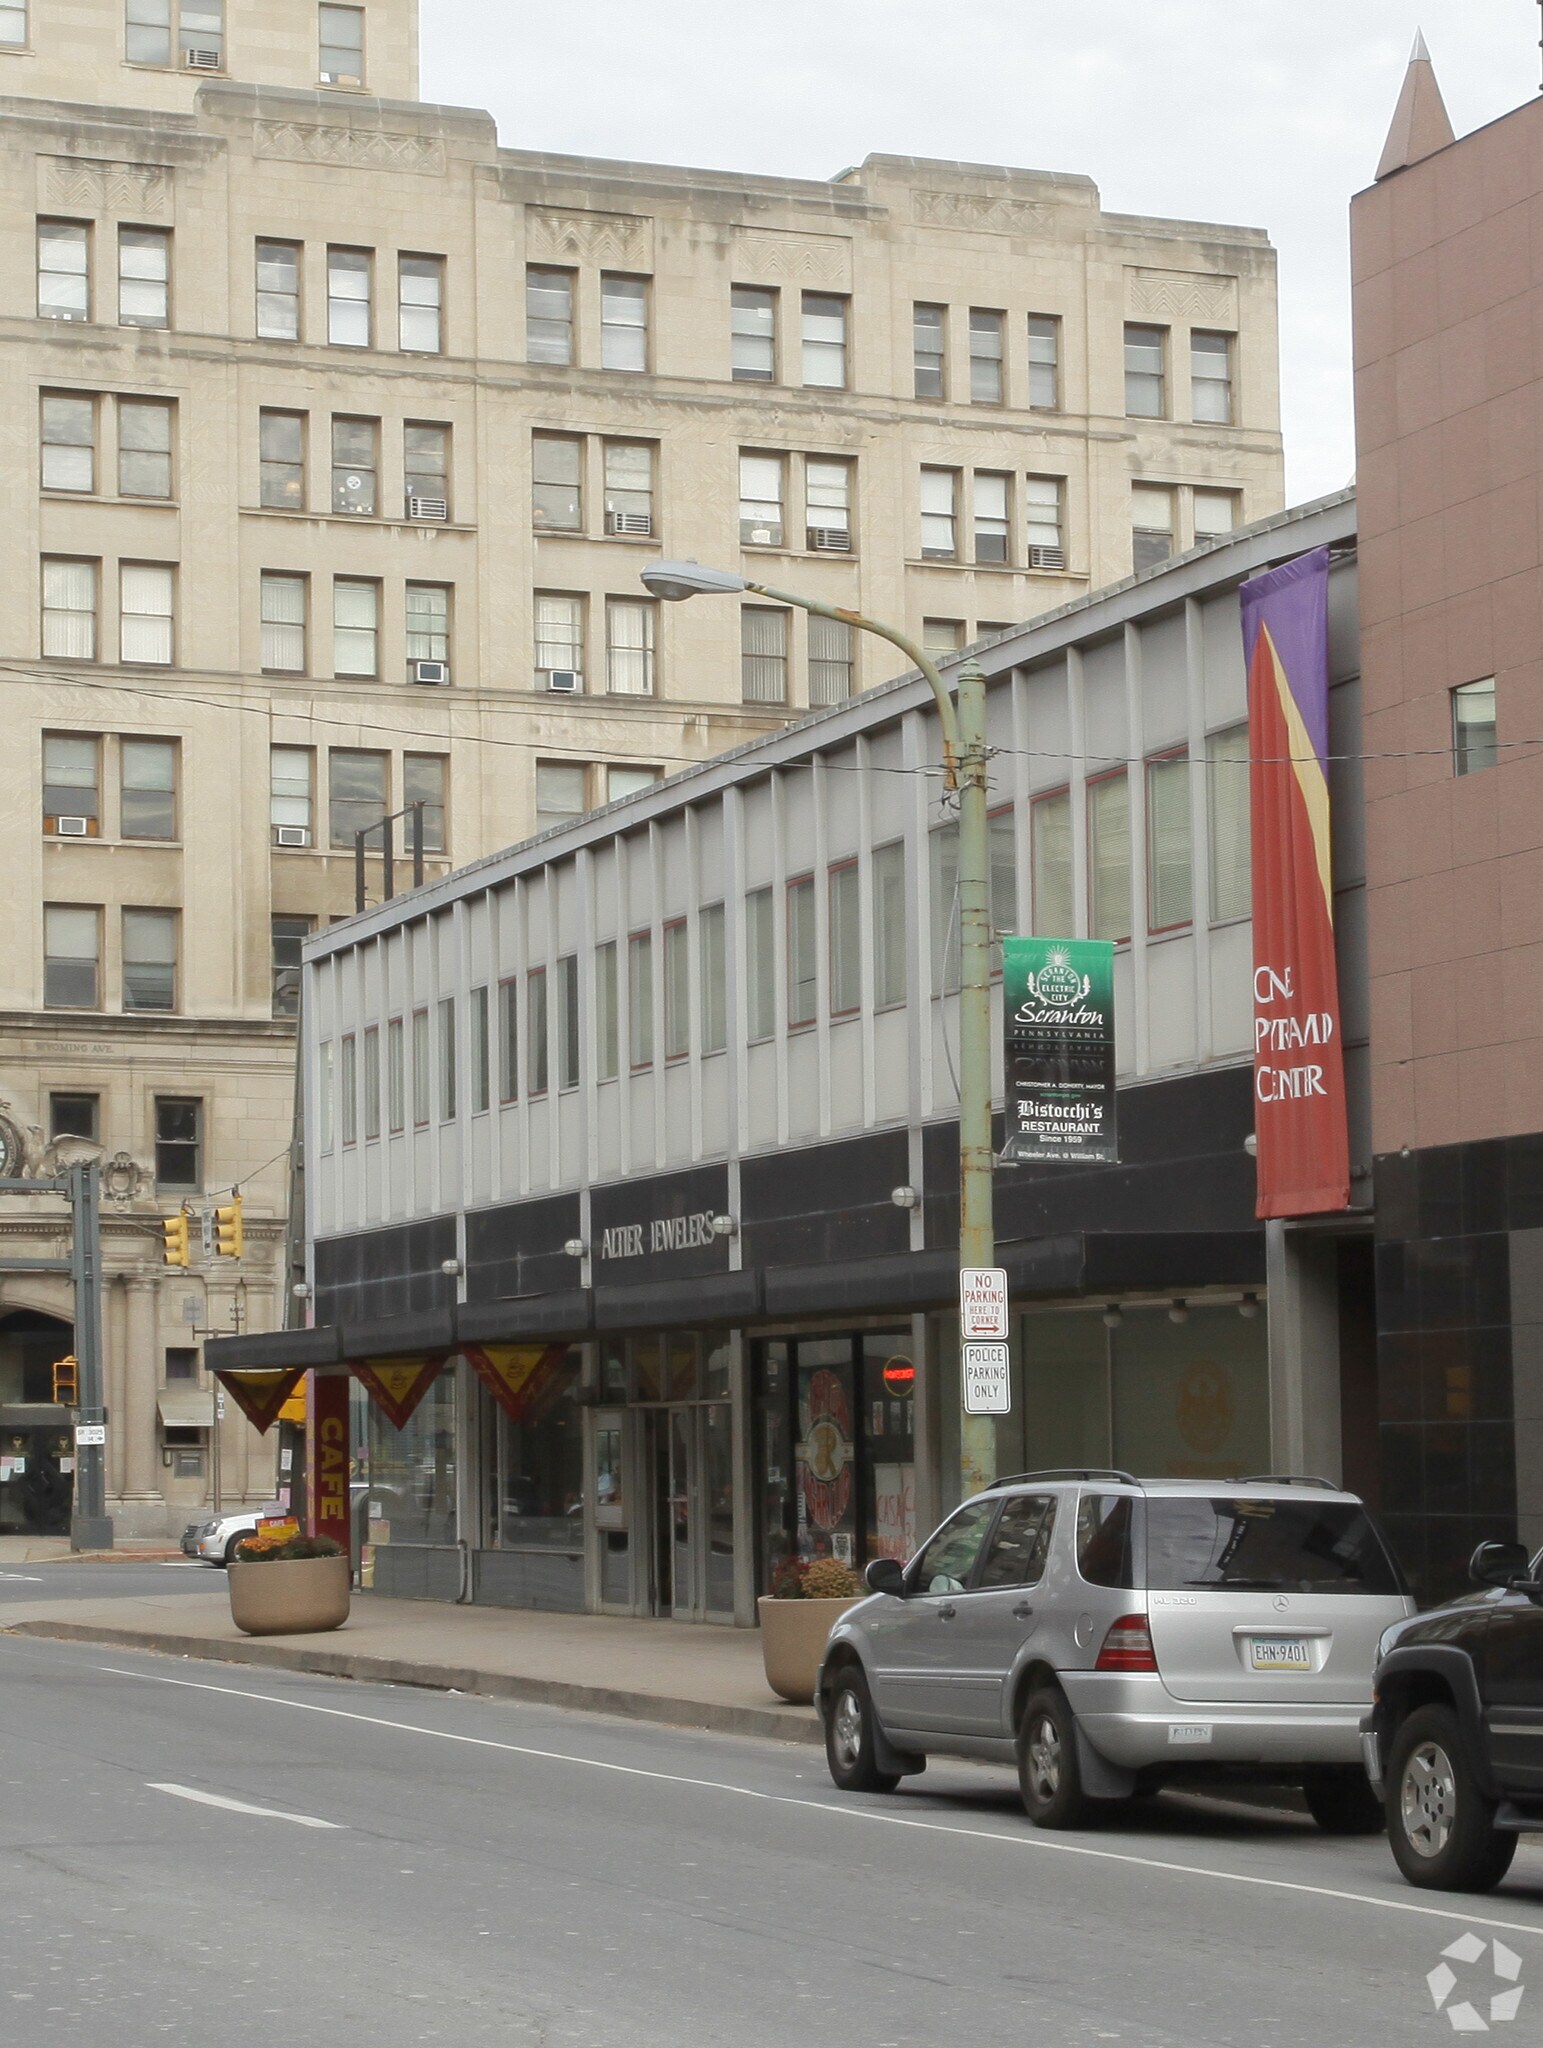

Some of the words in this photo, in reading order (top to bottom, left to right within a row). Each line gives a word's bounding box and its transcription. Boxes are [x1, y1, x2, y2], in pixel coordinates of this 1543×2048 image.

[1053, 975, 1065, 983] THE
[1042, 984, 1075, 993] ELECTRIC
[1052, 994, 1068, 1002] CITY
[1015, 1001, 1103, 1025] Scranton
[1014, 1029, 1104, 1038] PENNSYLVANIA
[1017, 1100, 1103, 1121] Bistocchi's
[1021, 1121, 1100, 1133] RESTAURANT
[1039, 1134, 1062, 1143] Since
[1064, 1135, 1082, 1143] 1959
[602, 1224, 644, 1259] ALTER
[650, 1210, 716, 1254] JEWELERS
[975, 1275, 992, 1288] NO
[965, 1290, 1004, 1304] PARKING
[970, 1305, 986, 1314] HERE
[990, 1305, 999, 1314] TO
[971, 1315, 999, 1325] CORNER
[969, 1348, 1003, 1362] POLICE
[968, 1367, 1005, 1380] PARKING
[974, 1385, 998, 1398] ONLY
[321, 1417, 344, 1520] CAFE
